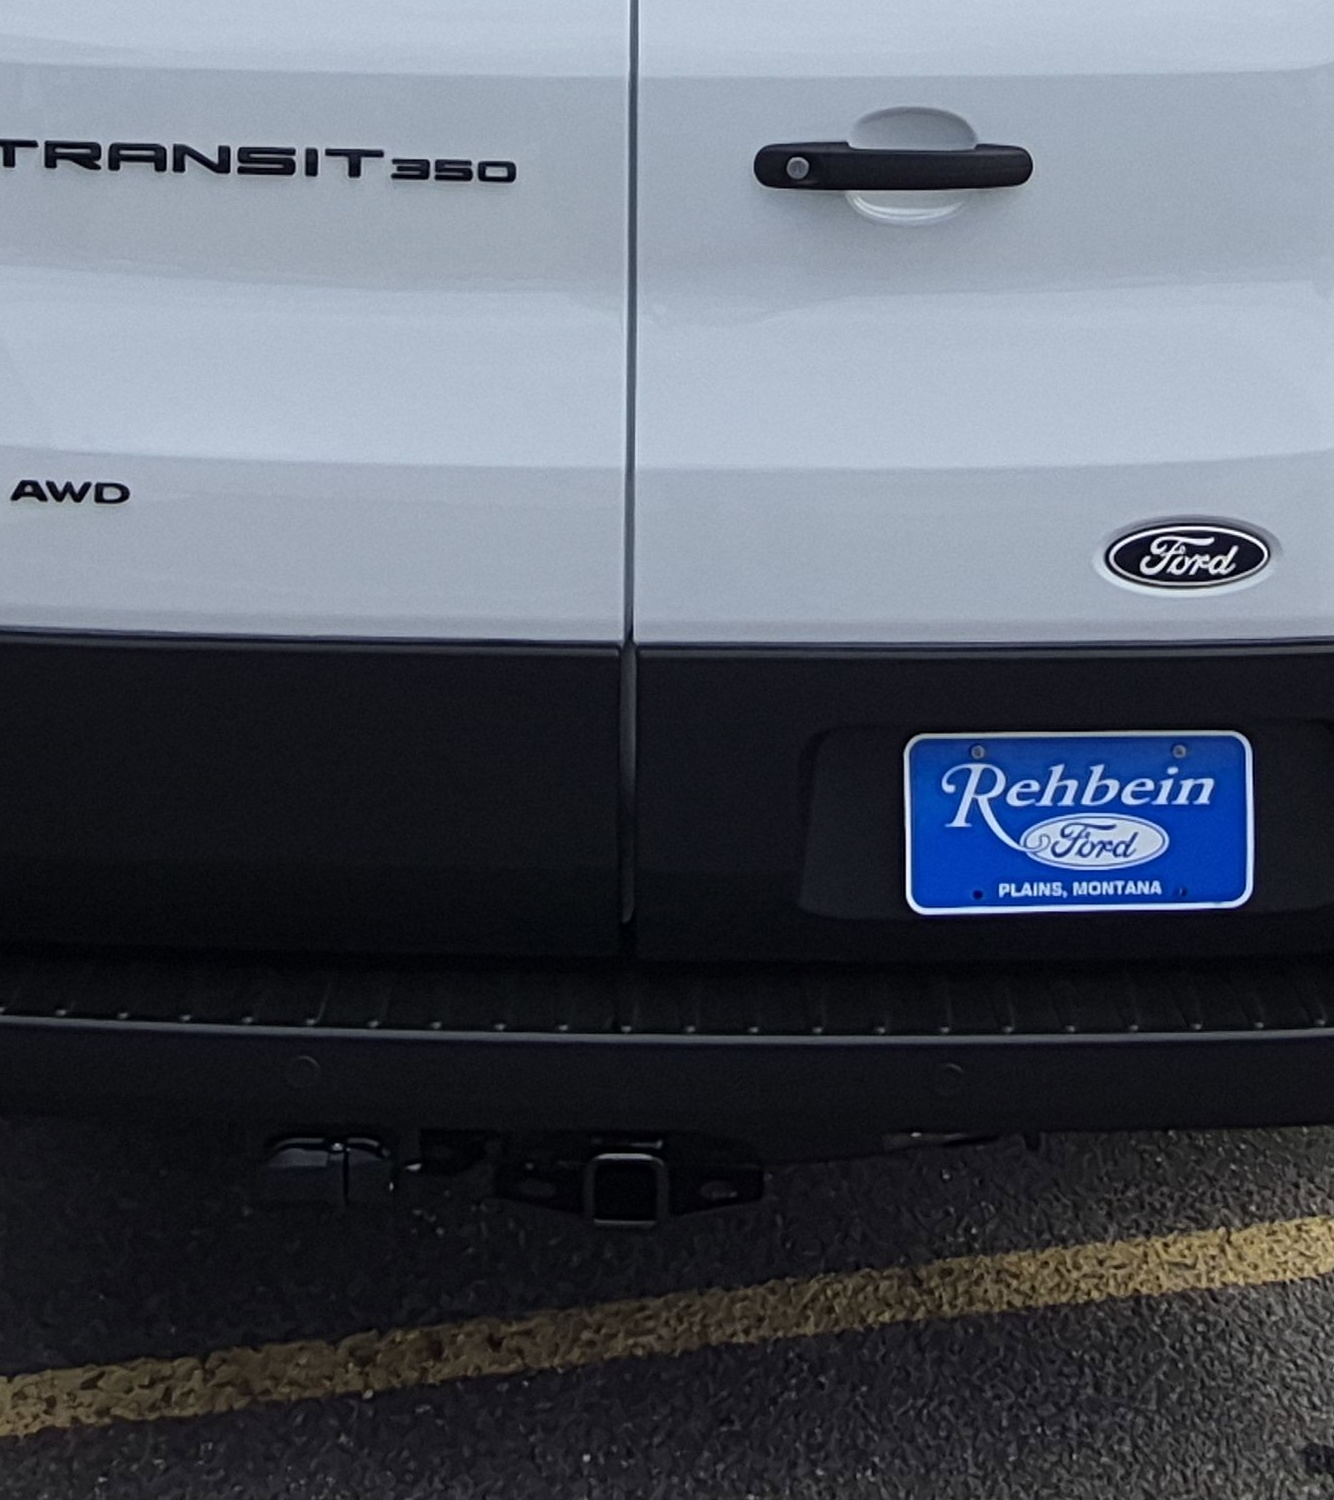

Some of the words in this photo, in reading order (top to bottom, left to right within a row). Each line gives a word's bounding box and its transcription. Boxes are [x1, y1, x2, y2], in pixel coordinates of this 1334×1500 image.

[390, 158, 518, 184] 350
[9, 479, 131, 505] AWD
[1139, 534, 1240, 577] Ford
[941, 763, 1215, 845] Rehbein
[1051, 822, 1137, 859] Ford
[998, 882, 1068, 899] PLAINS,
[1072, 880, 1163, 897] MONTANA
